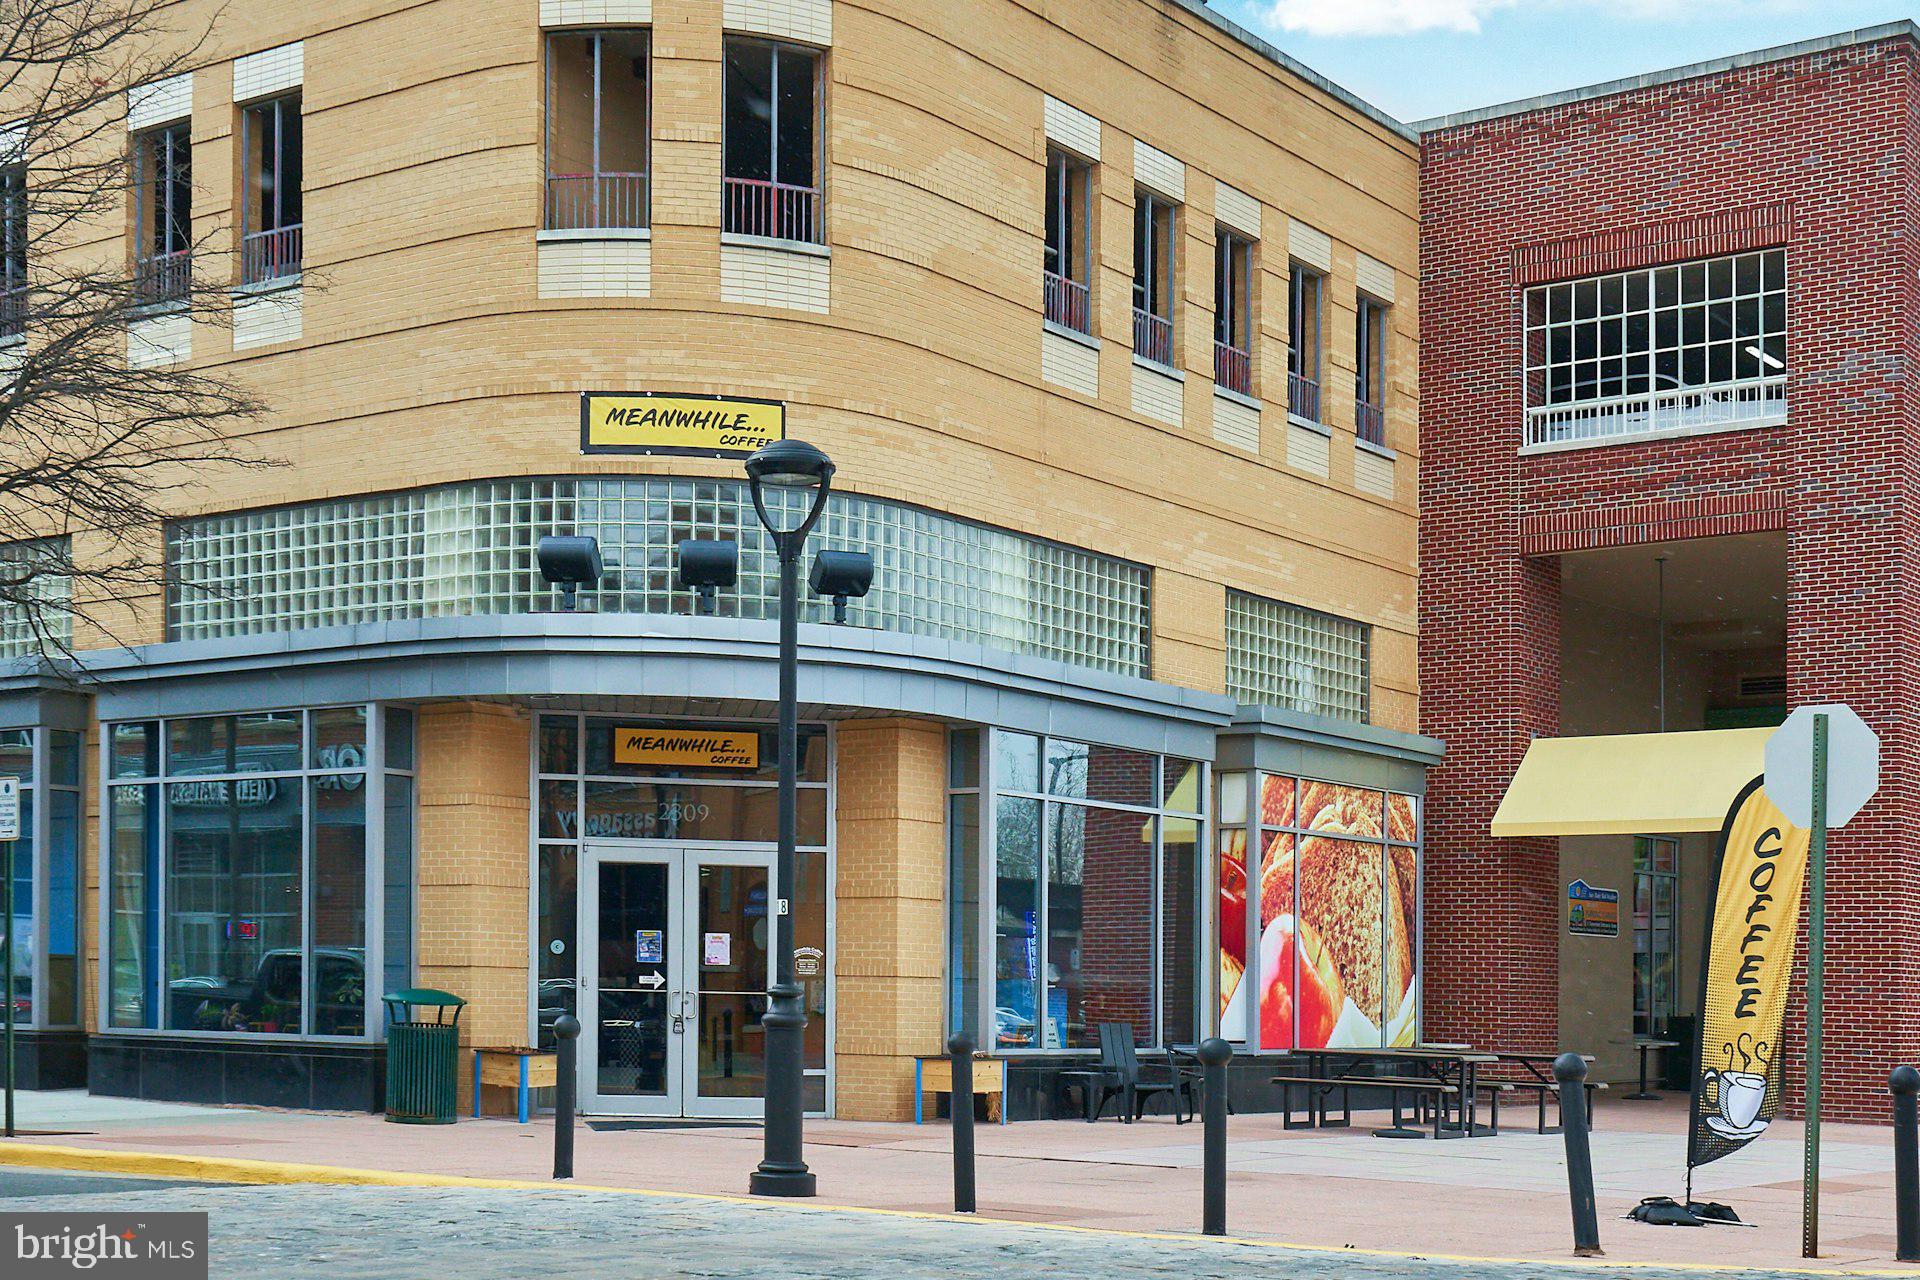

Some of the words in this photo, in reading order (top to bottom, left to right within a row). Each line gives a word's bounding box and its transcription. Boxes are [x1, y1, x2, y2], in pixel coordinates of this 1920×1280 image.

[605, 407, 766, 433] MEANWHILE...
[626, 736, 746, 754] MEANWHILE...
[710, 755, 752, 765] COFFEE
[1733, 827, 1783, 1019] COFFEE
